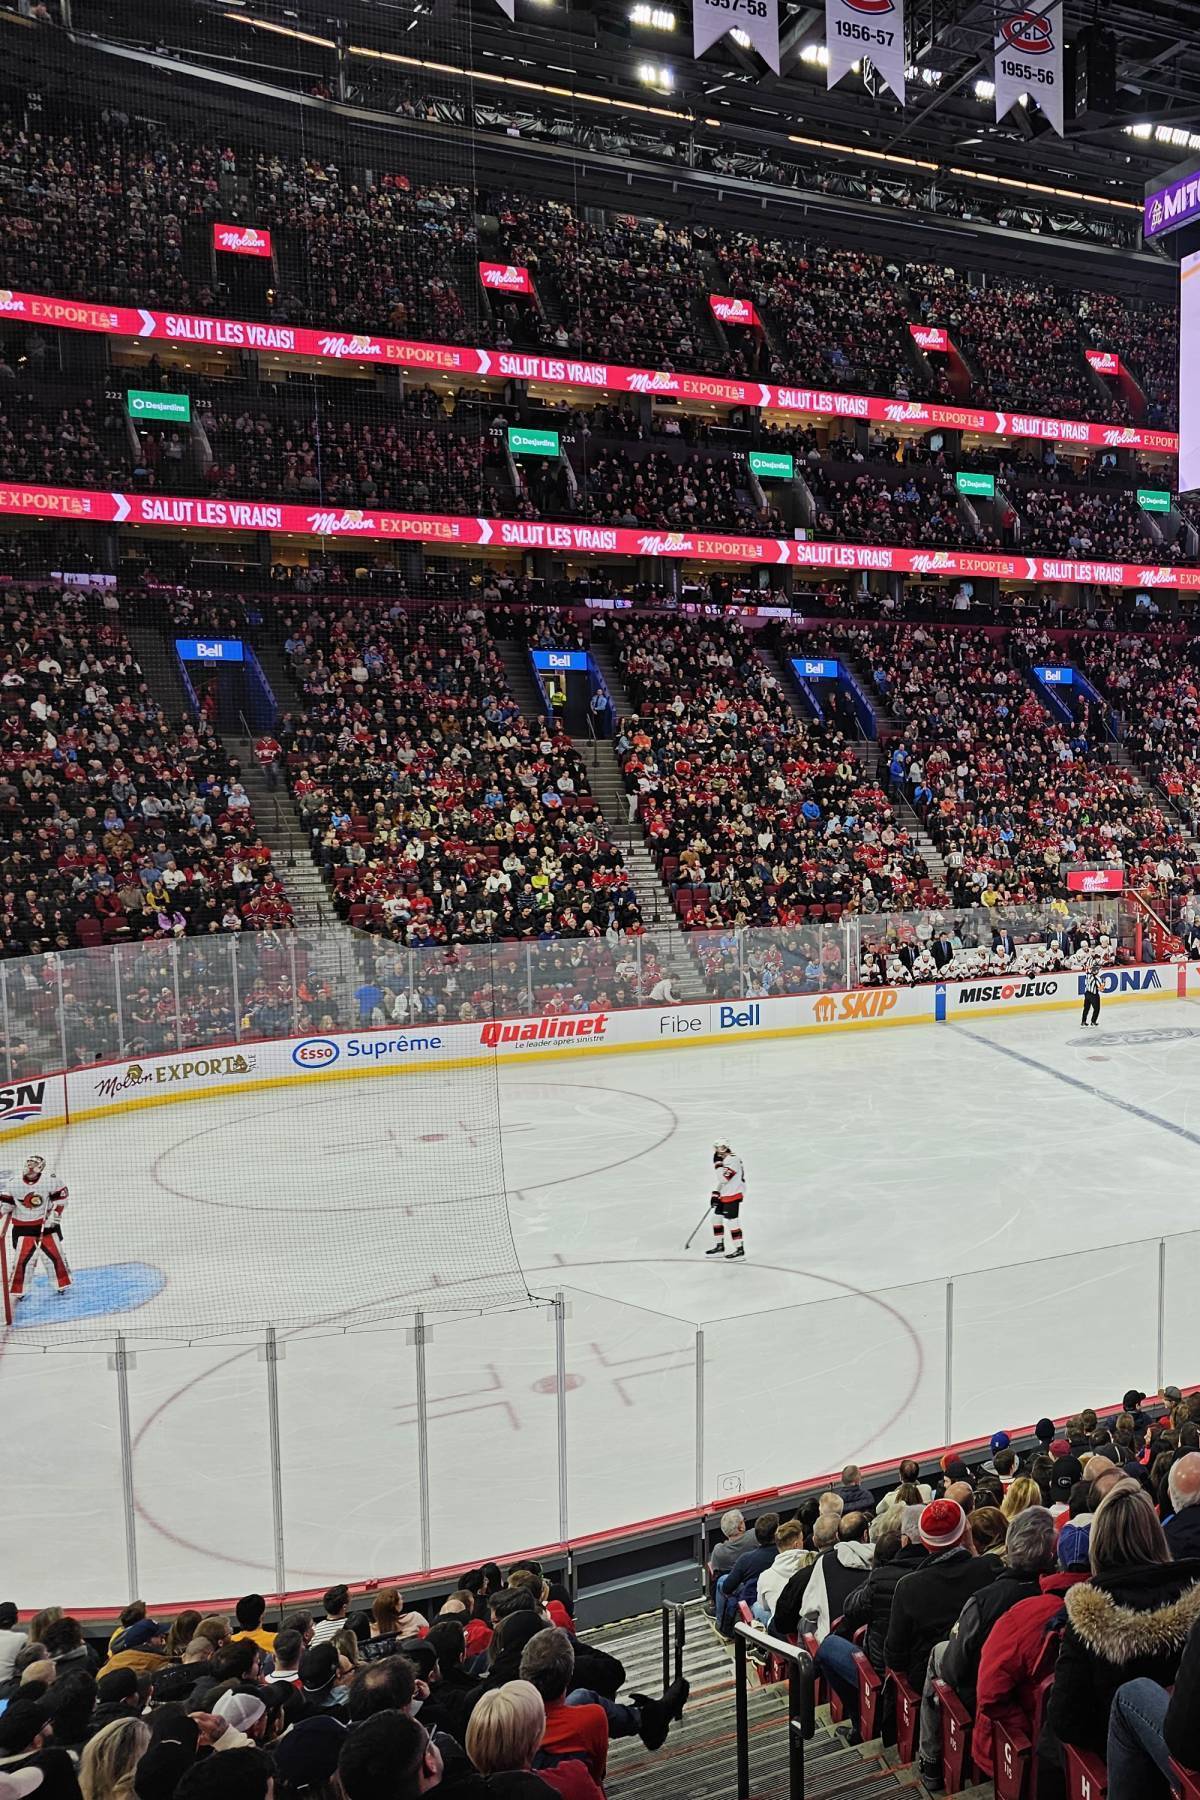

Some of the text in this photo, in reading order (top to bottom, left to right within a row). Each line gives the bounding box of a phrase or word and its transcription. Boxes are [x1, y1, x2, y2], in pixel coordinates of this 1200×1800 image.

[835, 20, 895, 47] 1956-57
[1001, 59, 1055, 85] 1955-56
[219, 231, 266, 247] Molson
[482, 269, 524, 284] Molson
[32, 302, 441, 364] Molson EXPORT EXPORT
[627, 372, 731, 398] Molson EXPORT
[144, 401, 186, 413] Desjardins
[885, 403, 972, 426] Molson EXPORT
[522, 437, 556, 447] Desjardins
[1103, 428, 1178, 448] Molson EXPORT
[761, 460, 790, 471] Desjardins
[966, 480, 992, 489] Desjardins
[307, 512, 442, 536] Molson EXPORT
[547, 527, 616, 549] LES VRAIS!
[638, 533, 749, 558] Molson EXPORT
[798, 544, 892, 568] SALUT LES VRAIS!
[910, 552, 1001, 574] Molson EXPORT
[1043, 562, 1122, 582] SALUT LES VRAIS!
[1138, 568, 1177, 587] Molson
[197, 643, 223, 657] Bell
[548, 654, 571, 667] Bell
[805, 662, 824, 675] Bell
[1044, 669, 1061, 681] Bell
[838, 990, 898, 1020] SKIP
[660, 1004, 760, 1034] Fibe Bell
[480, 1013, 609, 1047] Qualinet
[300, 1036, 443, 1060] Esso Suprême
[515, 1041, 524, 1049] Le
[526, 1039, 552, 1048] leader
[576, 1035, 604, 1044] sinistre
[95, 1057, 233, 1098] Molson EXPORT
[864, 1682, 871, 1697] D
[950, 1720, 957, 1734] F
[1004, 1743, 1012, 1764] G
[1004, 1764, 1013, 1780] 115
[1081, 1776, 1090, 1800] H
